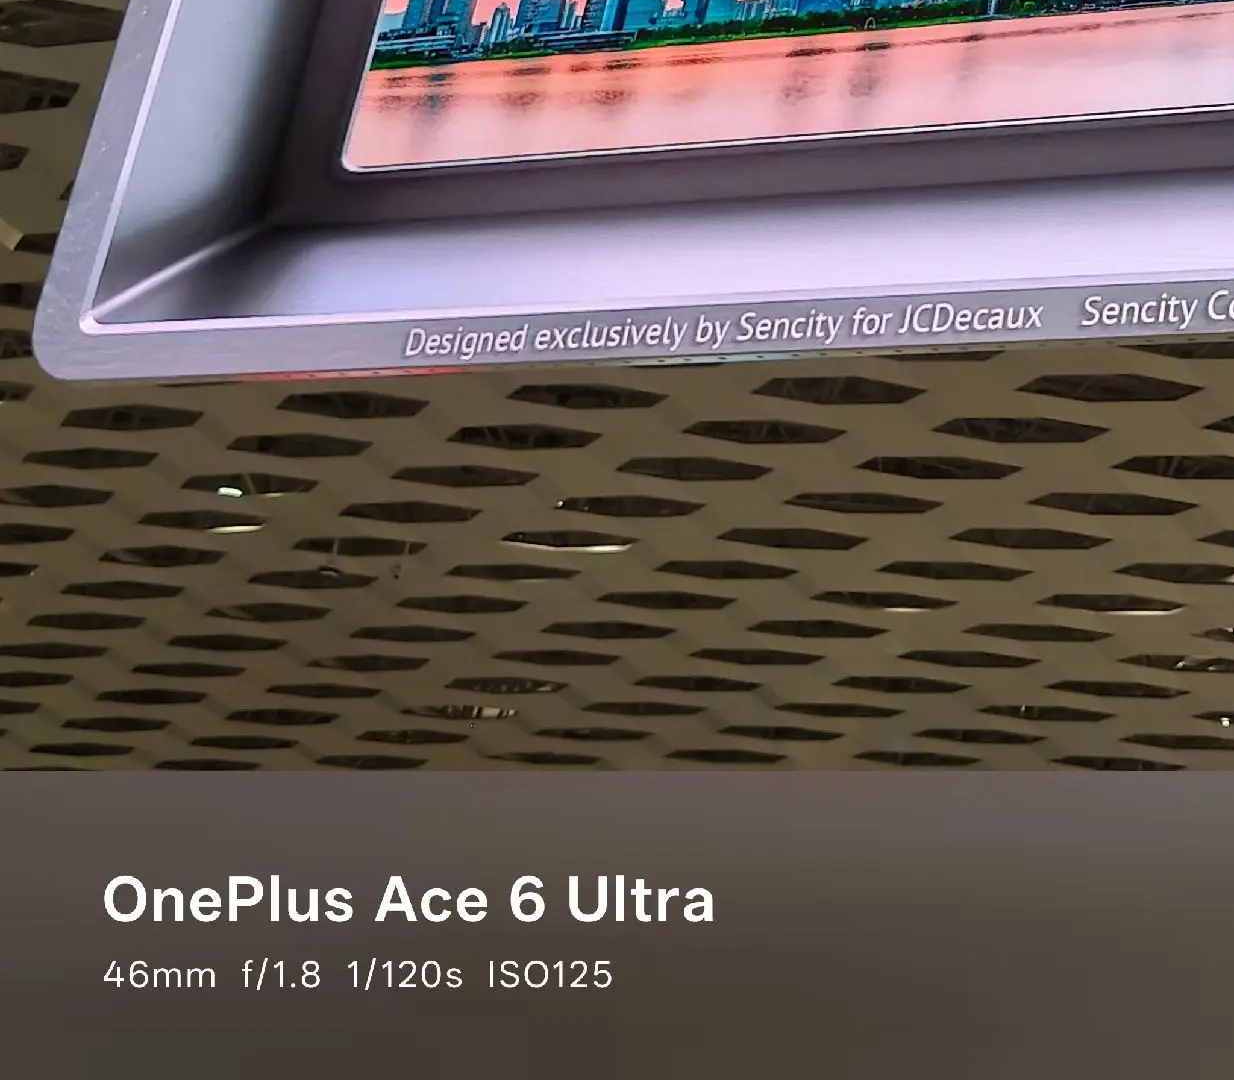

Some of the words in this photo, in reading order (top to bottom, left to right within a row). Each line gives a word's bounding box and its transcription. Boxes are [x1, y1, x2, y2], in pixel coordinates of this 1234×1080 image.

[405, 323, 528, 361] Designed
[534, 316, 688, 351] exclusively
[696, 314, 729, 349] by
[736, 308, 844, 344] Sencity
[852, 306, 894, 336] for
[898, 302, 1044, 335] JCDecaux
[1082, 292, 1199, 329] Sencity
